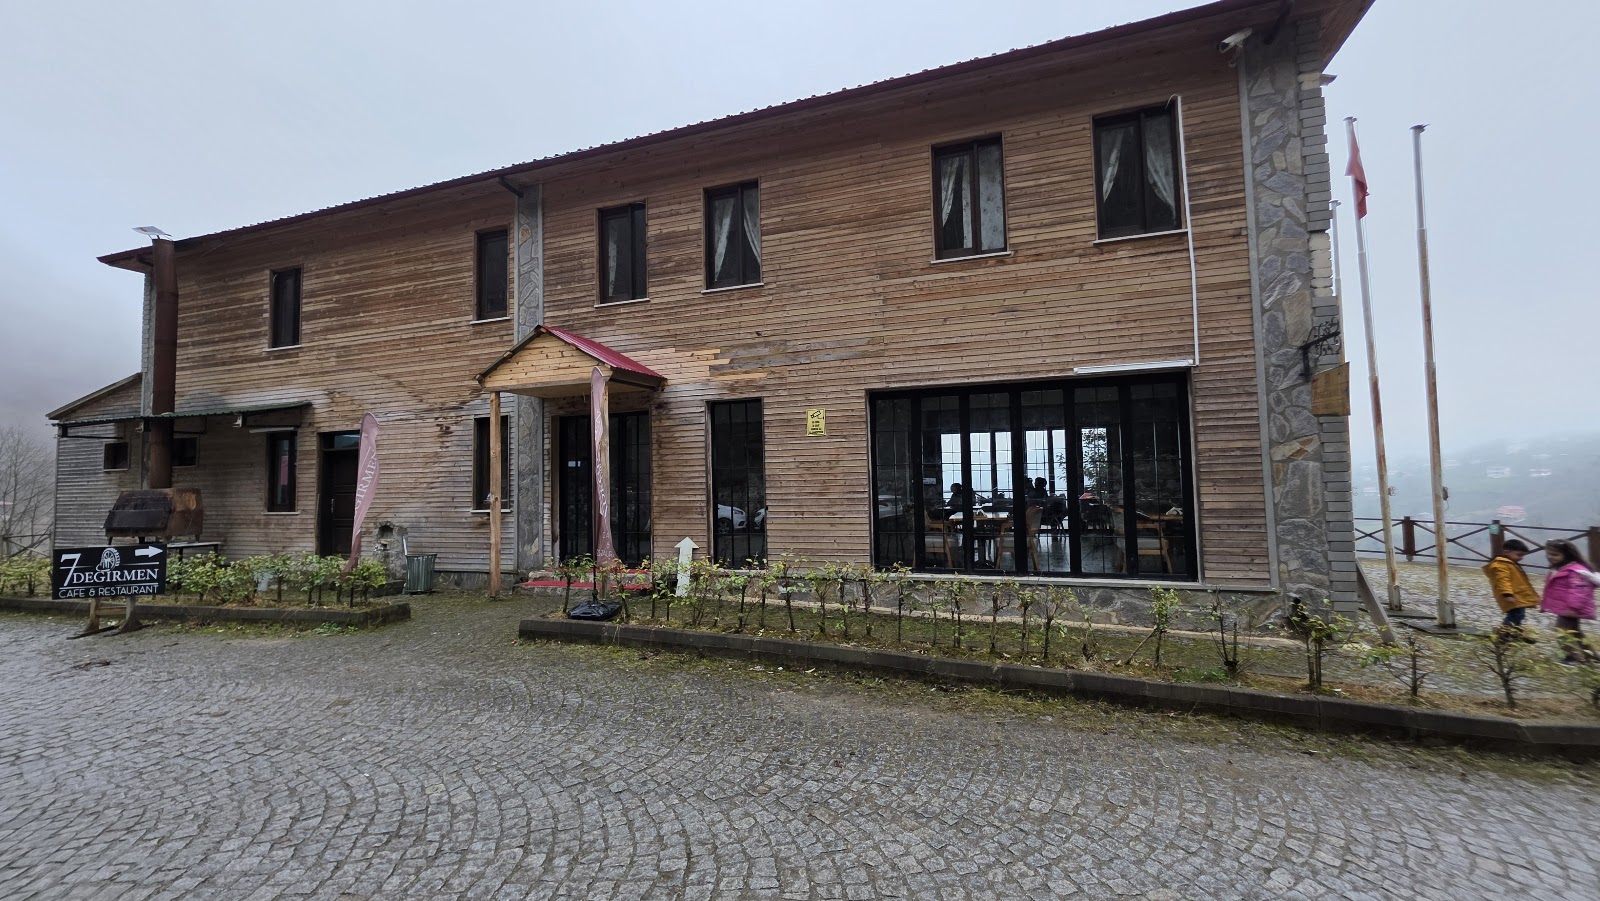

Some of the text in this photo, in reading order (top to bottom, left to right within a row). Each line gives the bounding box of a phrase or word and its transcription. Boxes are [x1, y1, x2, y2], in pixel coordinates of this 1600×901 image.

[60, 553, 82, 587] 7
[59, 585, 159, 599] CAFE & RESTAURANT
